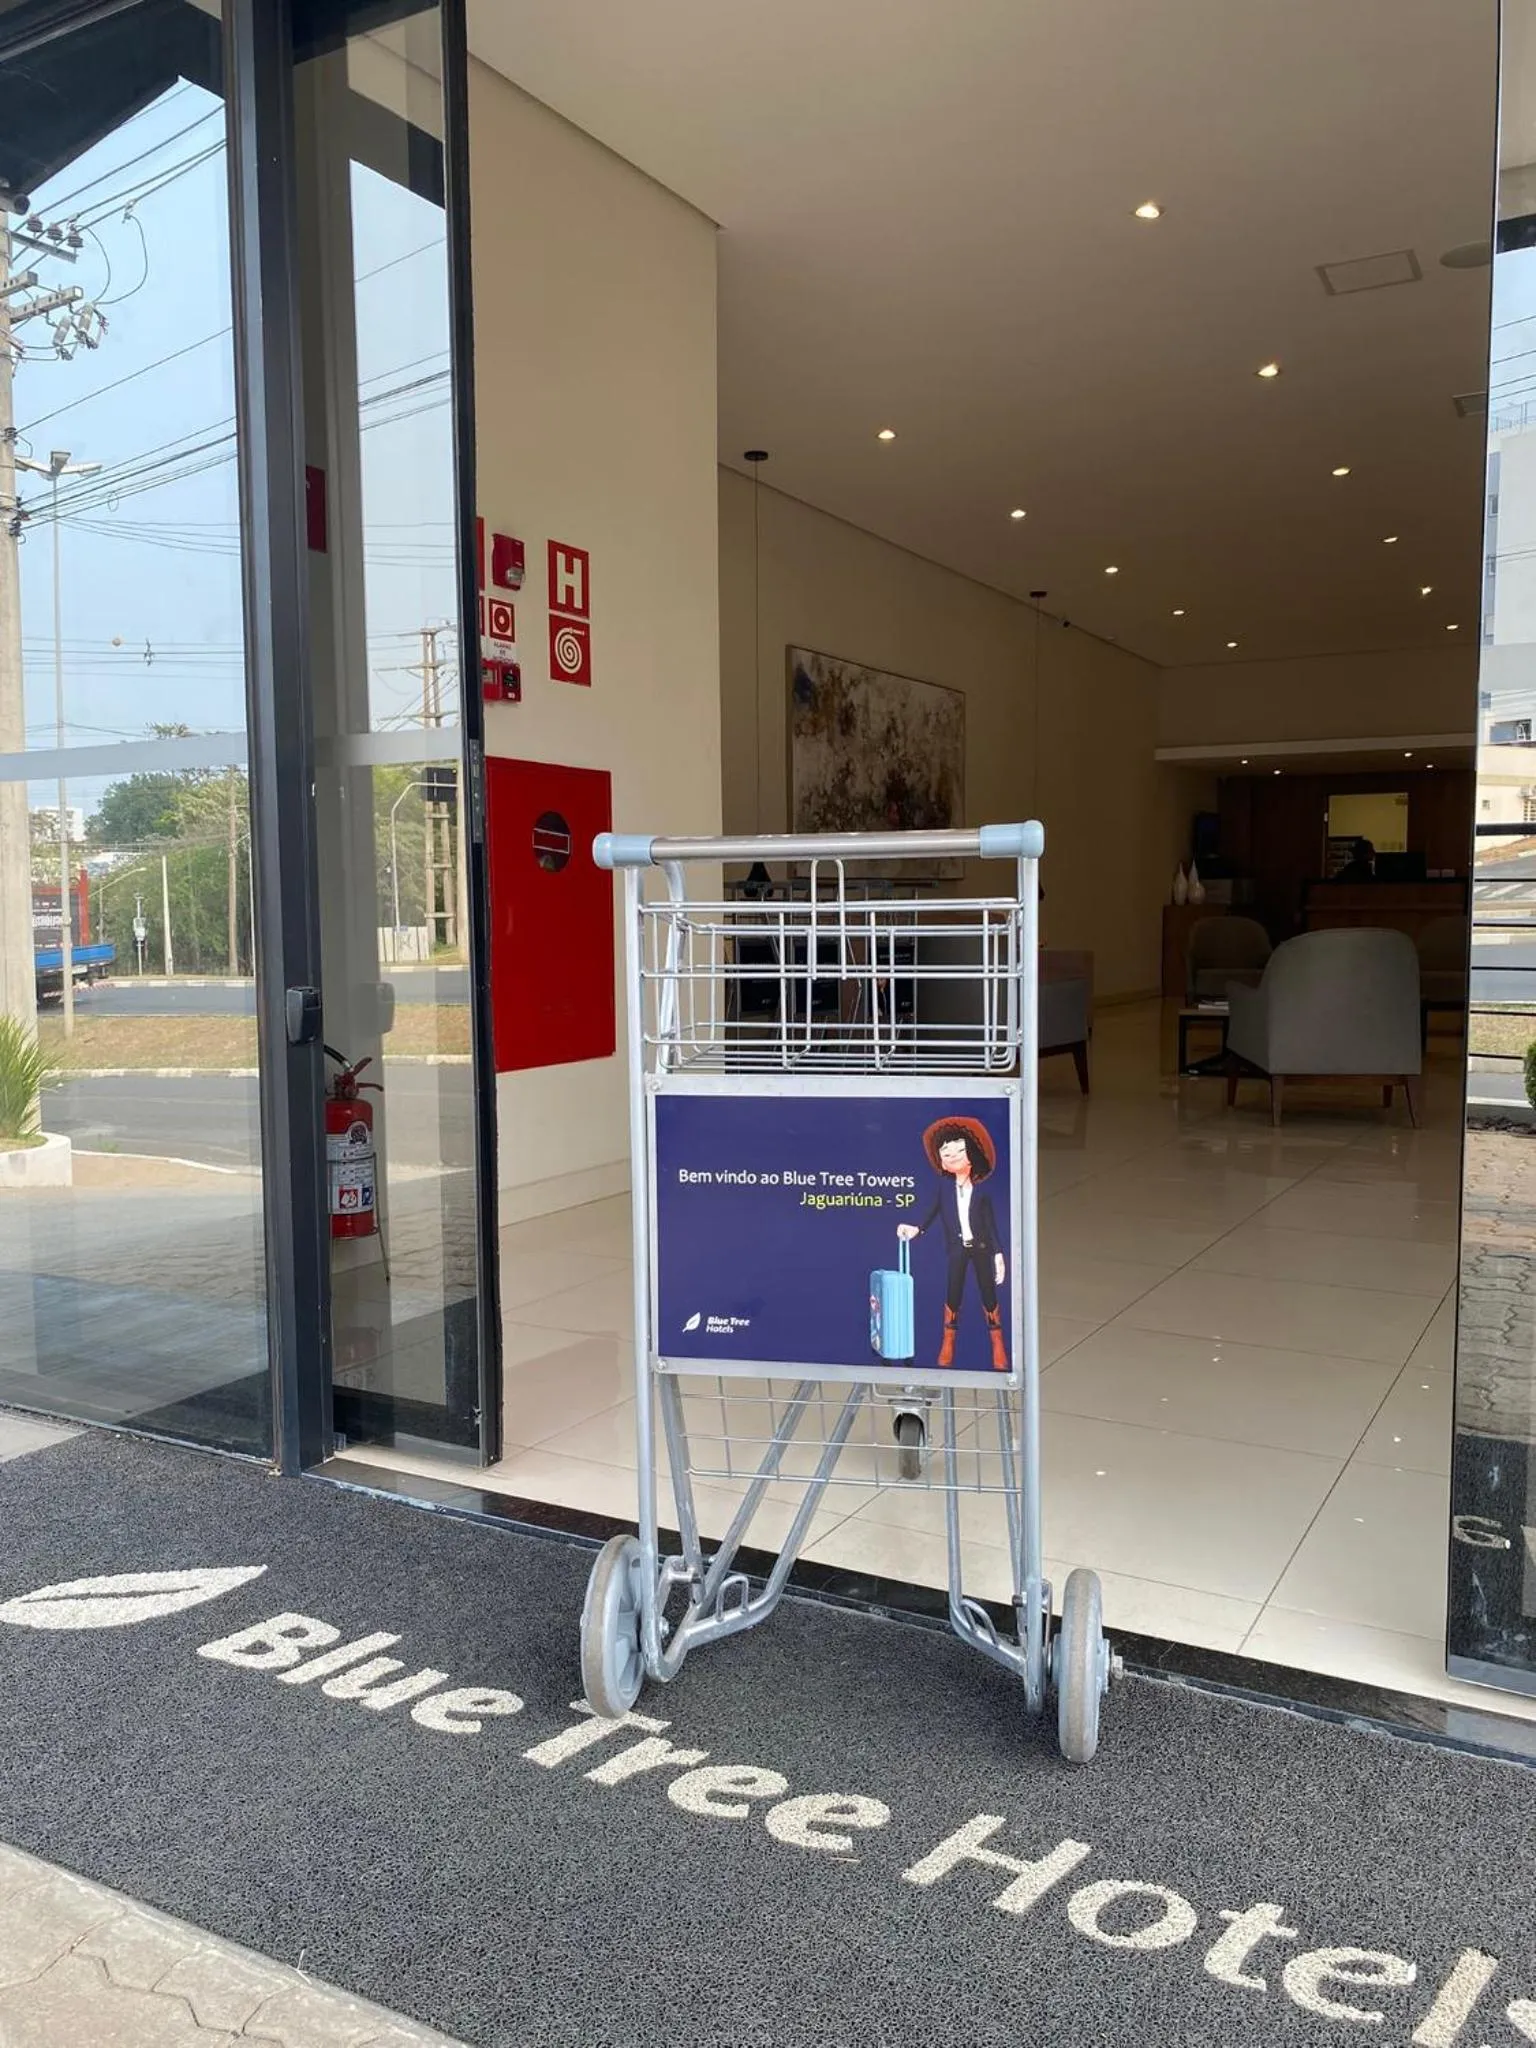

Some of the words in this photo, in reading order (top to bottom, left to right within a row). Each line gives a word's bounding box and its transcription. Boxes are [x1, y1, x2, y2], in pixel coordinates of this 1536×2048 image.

[556, 551, 583, 610] H
[679, 1168, 712, 1183] Bem
[715, 1169, 757, 1184] vindo
[760, 1173, 779, 1185] ao
[783, 1170, 816, 1185] Blue
[819, 1171, 854, 1186] Tree
[857, 1172, 915, 1188] Towers
[799, 1191, 883, 1210] Jaguariúna
[895, 1193, 916, 1208] SP
[706, 1324, 734, 1333] Hotels
[708, 1316, 729, 1325] Blue
[730, 1317, 750, 1326] Tree
[198, 1612, 525, 1734] Blue
[522, 1699, 891, 1852] Tree
